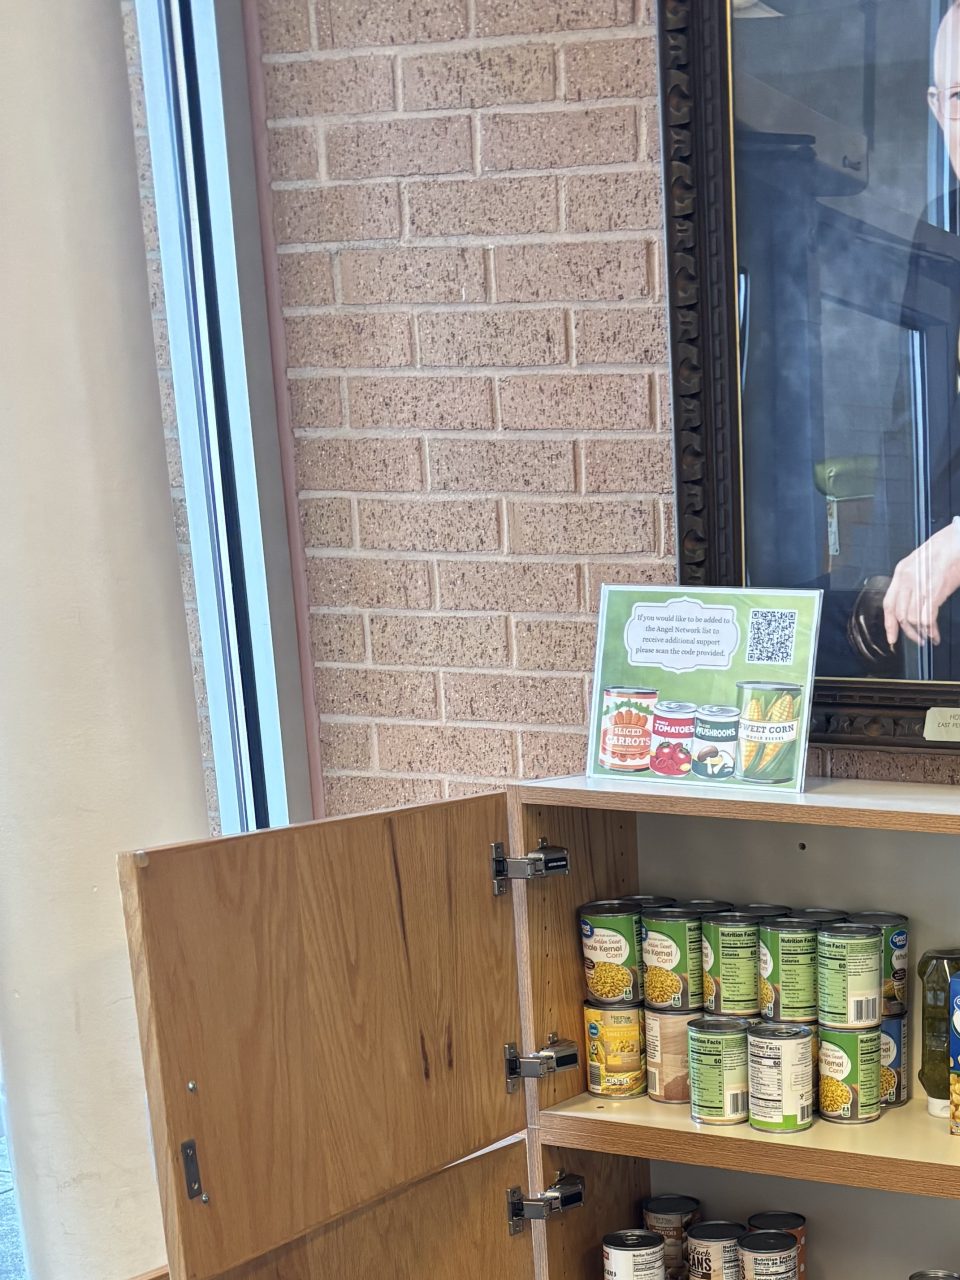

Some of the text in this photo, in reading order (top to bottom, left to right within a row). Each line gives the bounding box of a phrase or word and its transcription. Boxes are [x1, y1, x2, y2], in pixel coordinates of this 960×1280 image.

[656, 626, 673, 634] Angel
[675, 626, 701, 634] Network
[635, 646, 654, 654] please
[615, 727, 643, 736] SLICED
[654, 724, 695, 733] TOMATOES
[696, 726, 736, 737] MUSHROOMS
[739, 723, 794, 734] SWEET CORN
[605, 735, 650, 746] CARROTS
[600, 945, 622, 953] Kernel
[652, 949, 673, 957] Kernel
